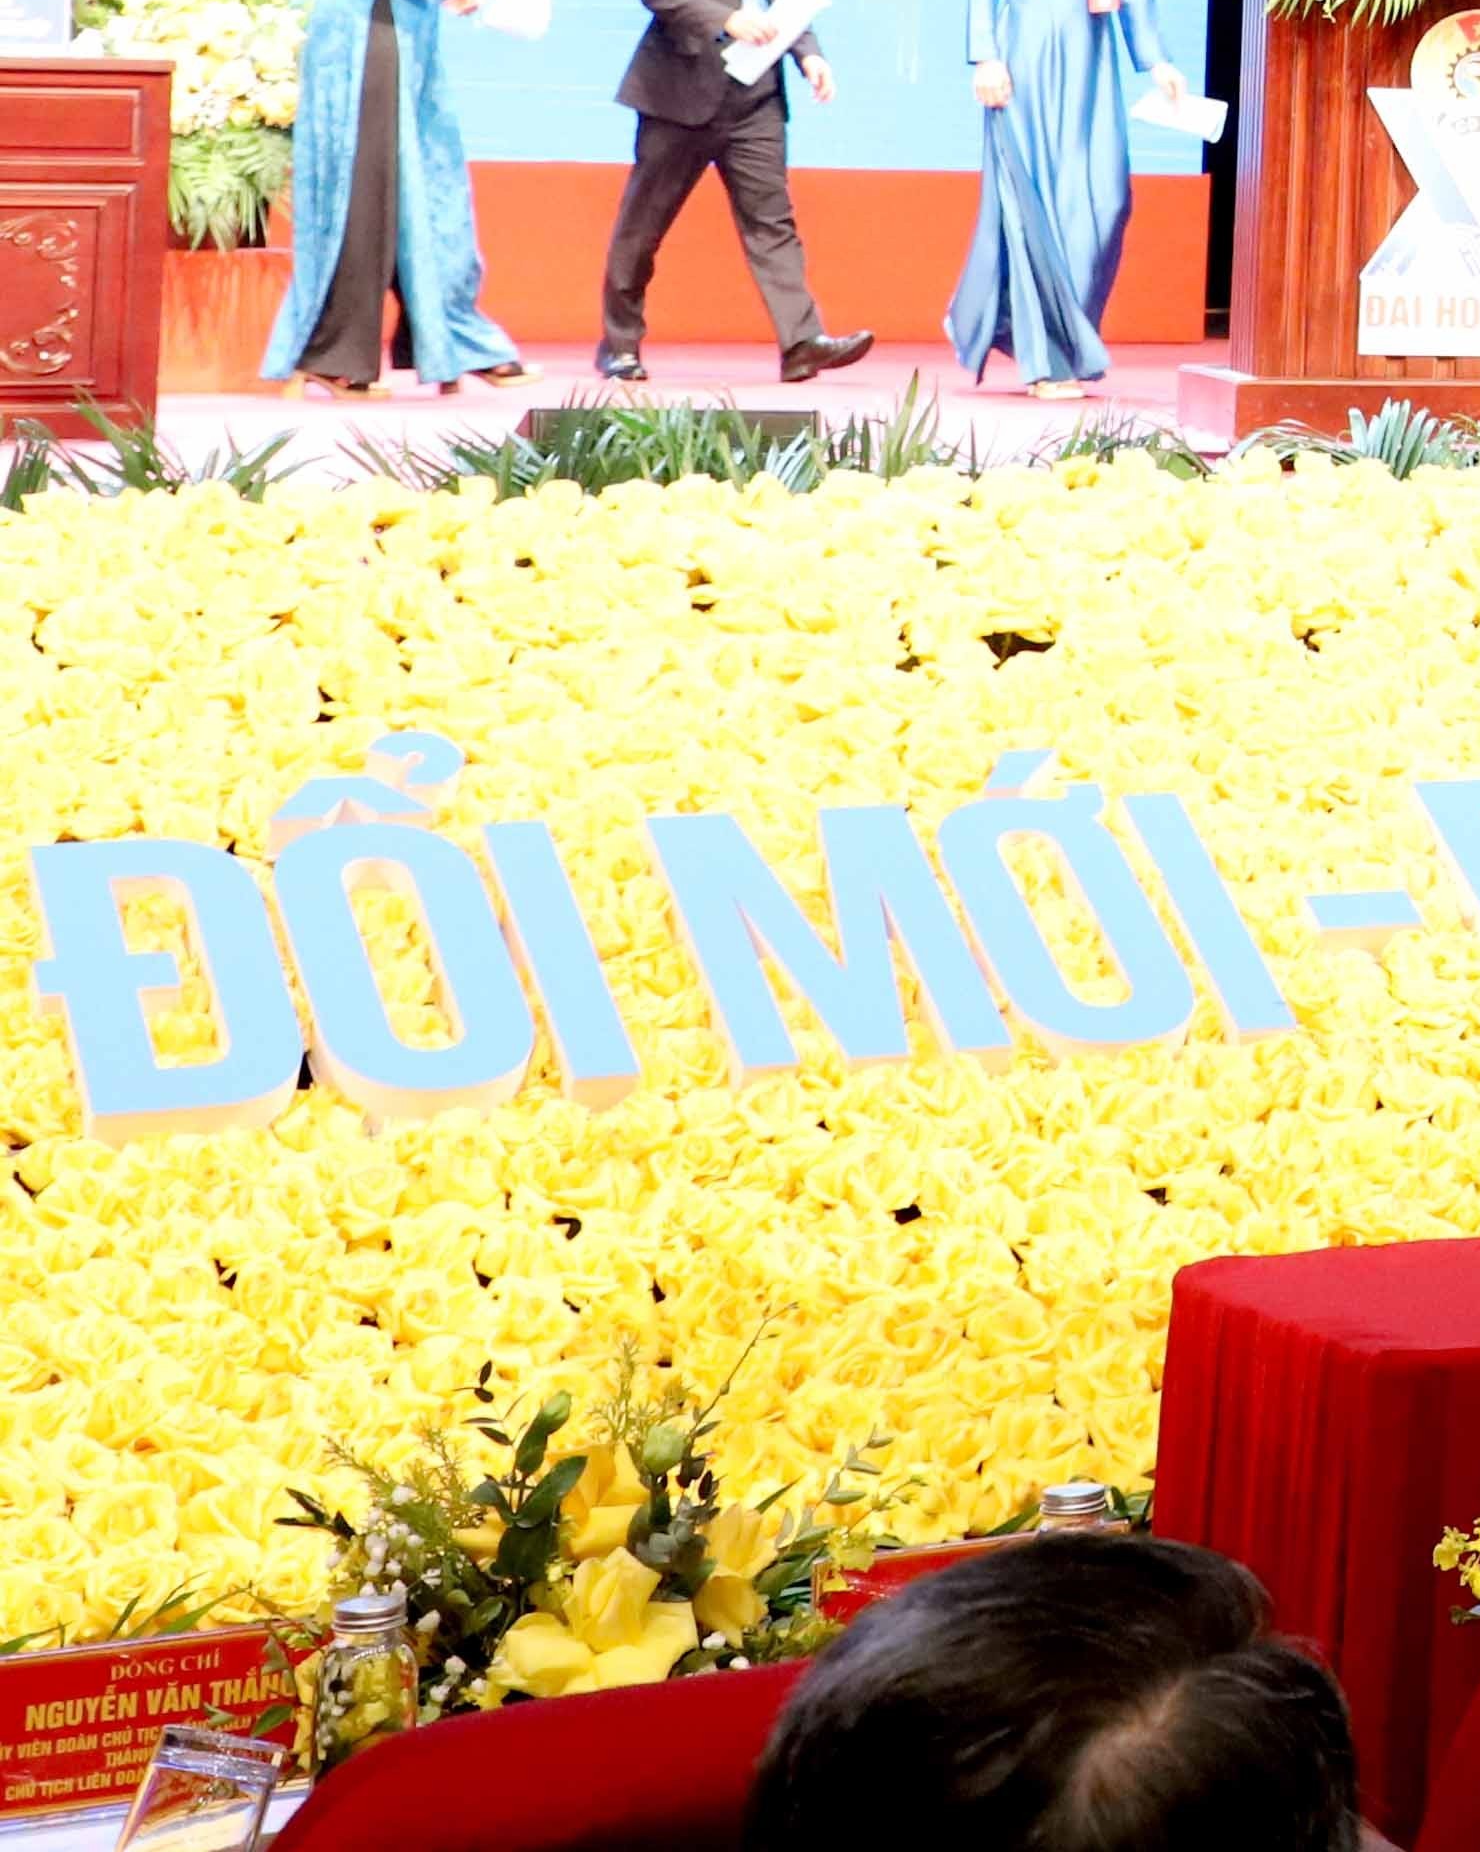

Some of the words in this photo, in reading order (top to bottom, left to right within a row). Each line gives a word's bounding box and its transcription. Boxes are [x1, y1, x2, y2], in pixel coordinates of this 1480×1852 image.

[26, 730, 644, 1133] ĐỔI
[645, 747, 1300, 1073] MỚI
[180, 1648, 222, 1672] CHÍ
[25, 1682, 139, 1732] NGUYỄN
[146, 1681, 201, 1716] VĂN
[137, 1725, 163, 1746] TỊC
